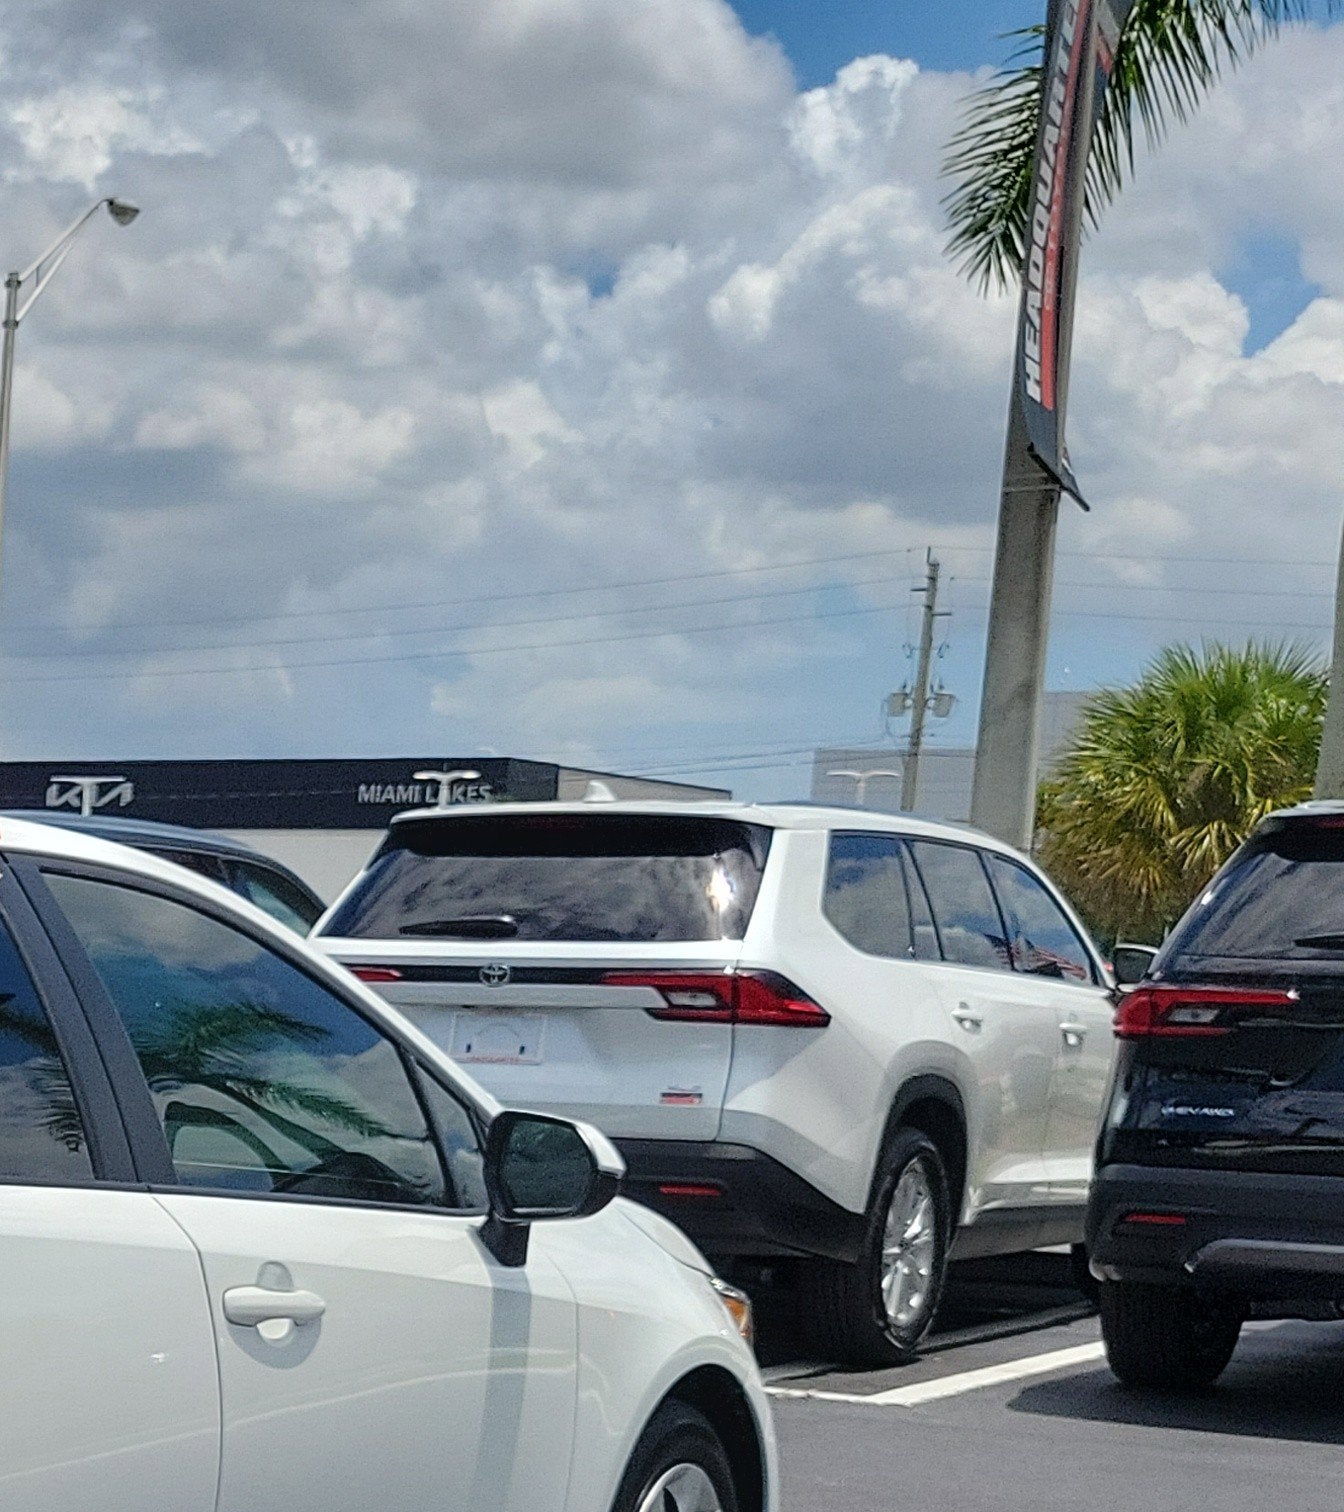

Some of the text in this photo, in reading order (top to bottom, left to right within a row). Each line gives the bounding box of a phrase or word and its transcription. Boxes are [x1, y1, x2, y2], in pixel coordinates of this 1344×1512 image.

[1024, 0, 1079, 404] HEADQUARTE
[358, 783, 496, 806] MIAMI LKES
